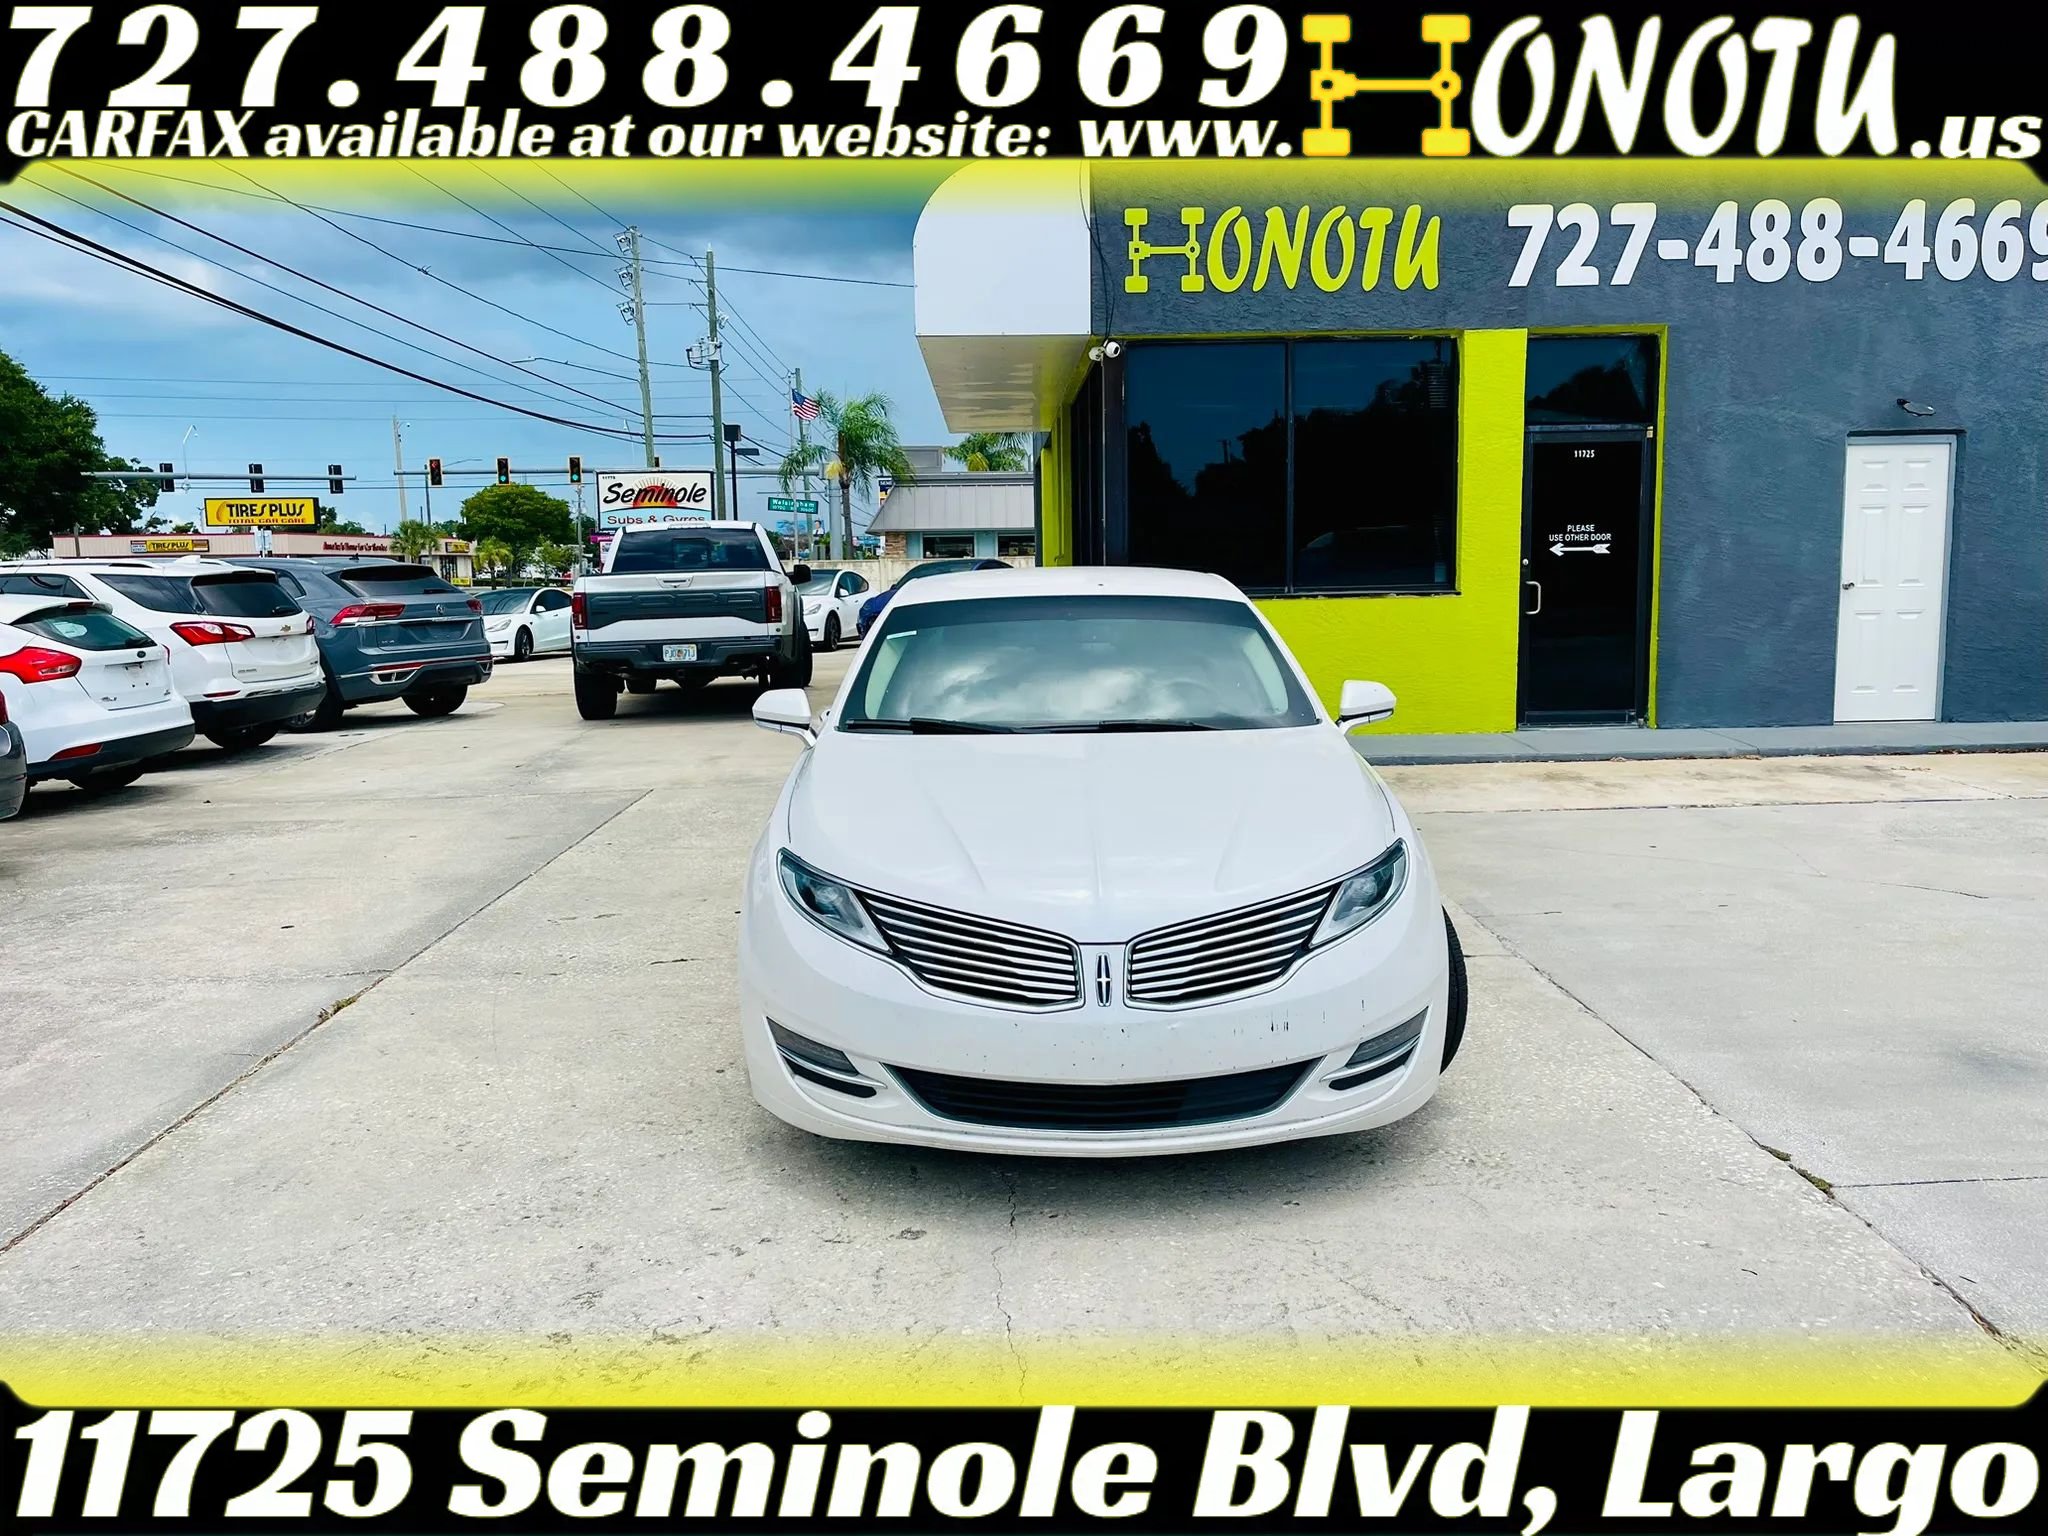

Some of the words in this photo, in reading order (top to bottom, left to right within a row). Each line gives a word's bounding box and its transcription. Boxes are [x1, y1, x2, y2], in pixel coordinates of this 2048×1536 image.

[1124, 200, 1441, 293] HONOTU
[1574, 449, 1596, 458] 11725
[602, 482, 707, 504] Seminole
[607, 515, 644, 525] Subs
[647, 515, 657, 523] &
[1567, 524, 1596, 532] PLEASE
[1548, 533, 1564, 542] USE
[1564, 533, 1590, 541] OTHER
[1590, 533, 1612, 541] DOOR
